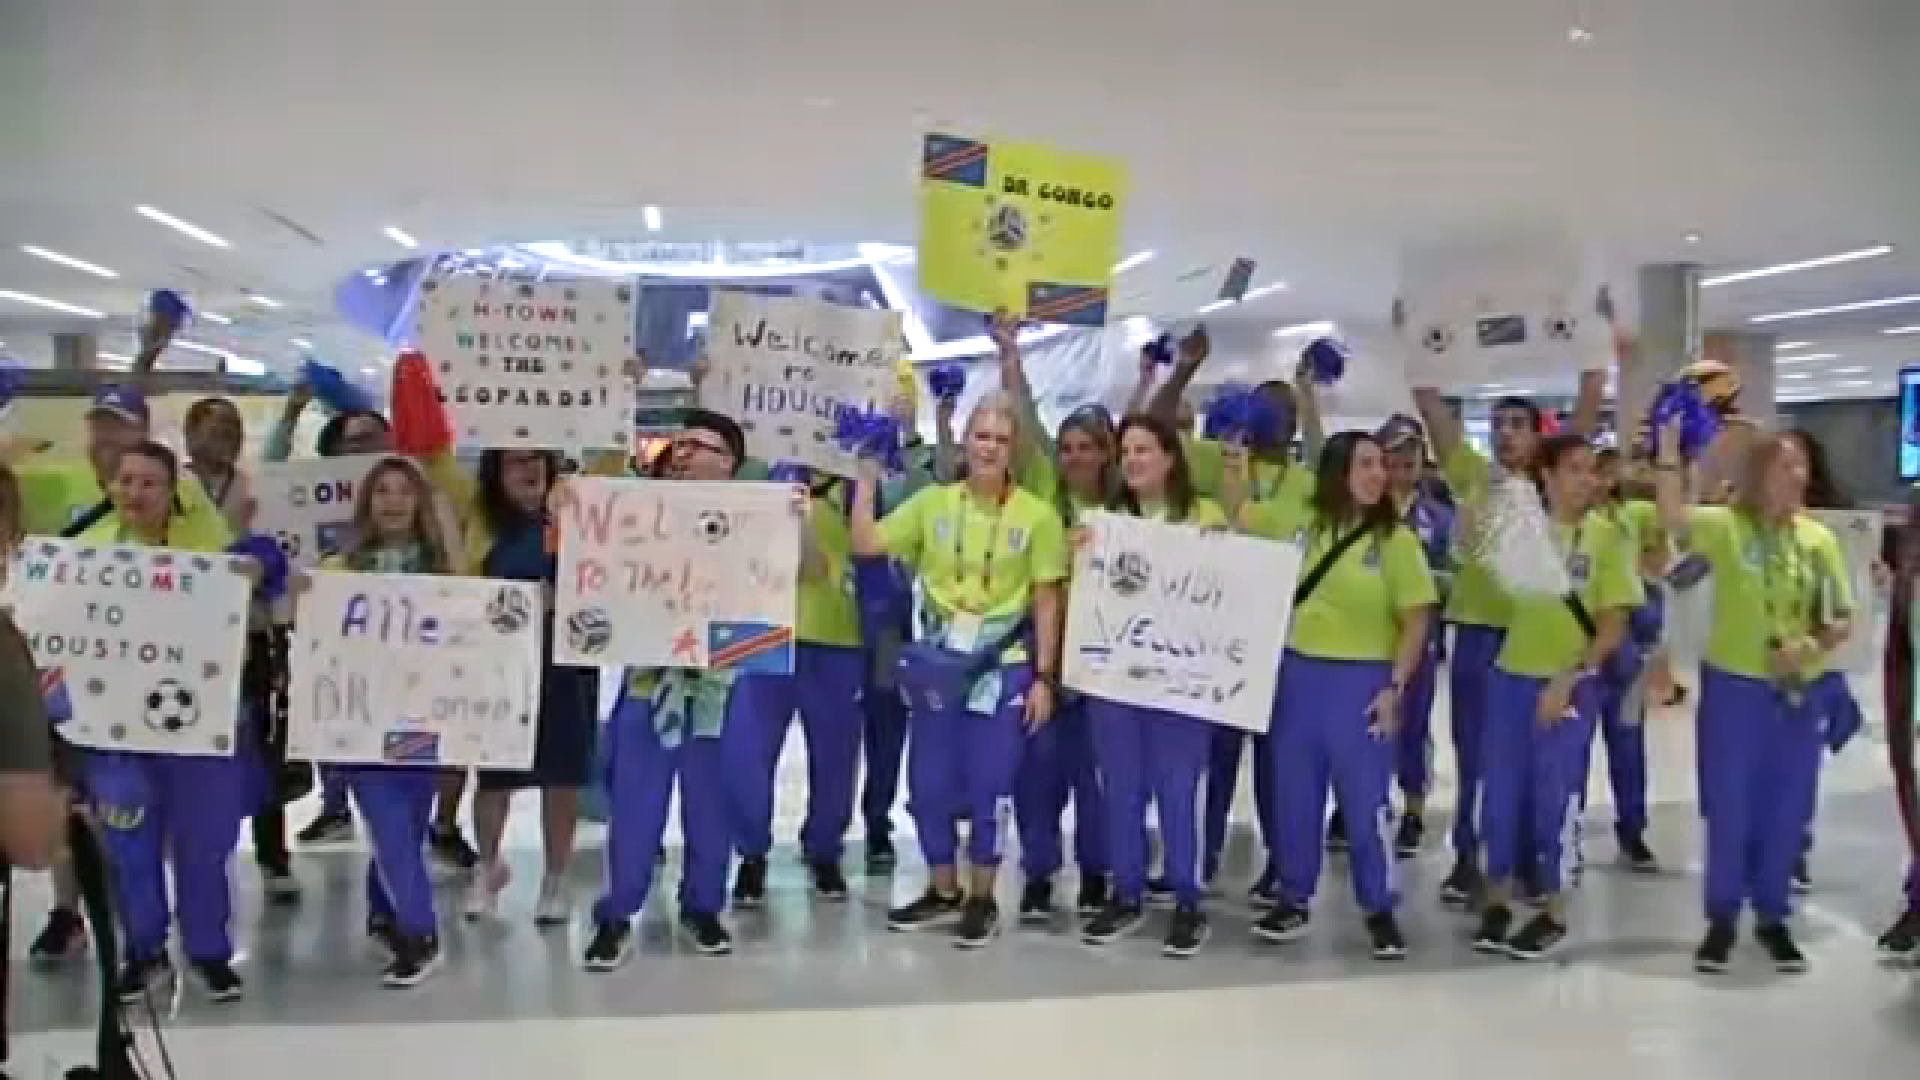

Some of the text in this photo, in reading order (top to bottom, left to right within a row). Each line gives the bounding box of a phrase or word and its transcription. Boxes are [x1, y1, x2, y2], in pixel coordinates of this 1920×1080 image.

[1004, 175, 1114, 210] DR CONGO
[473, 302, 577, 324] H-TOWN
[503, 356, 544, 373] THE
[26, 562, 194, 594] WELCOME
[84, 602, 124, 627] TO
[26, 632, 184, 664] HOUSTON
